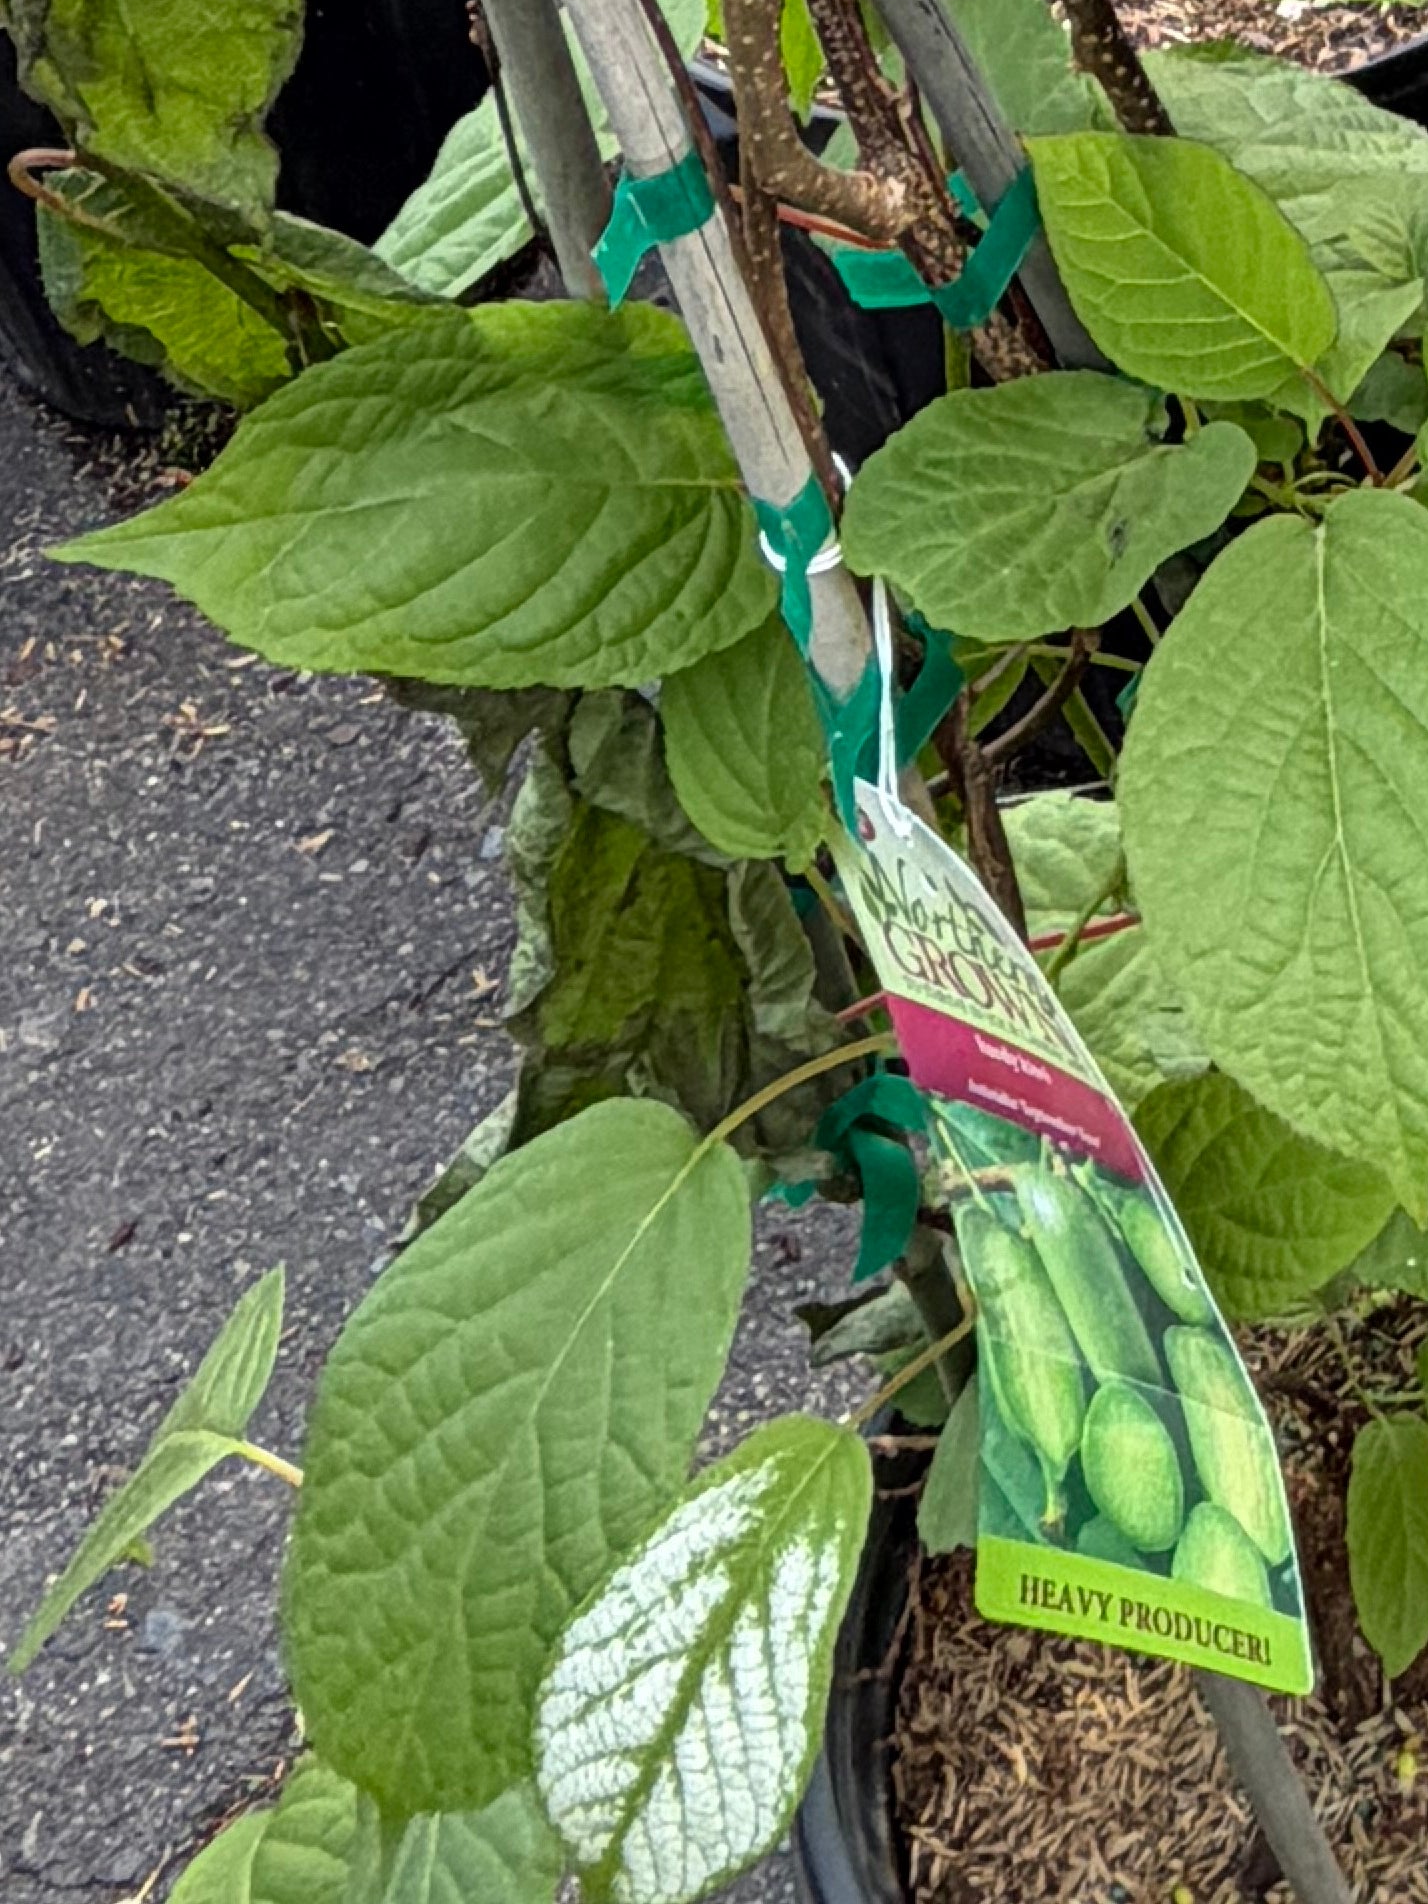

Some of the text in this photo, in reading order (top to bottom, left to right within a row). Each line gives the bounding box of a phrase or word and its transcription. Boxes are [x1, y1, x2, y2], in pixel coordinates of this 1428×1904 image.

[868, 853, 1052, 1002] Northern
[884, 920, 1078, 1058] GROWN
[1020, 1573, 1272, 1666] HEAVY PRODUCER!
